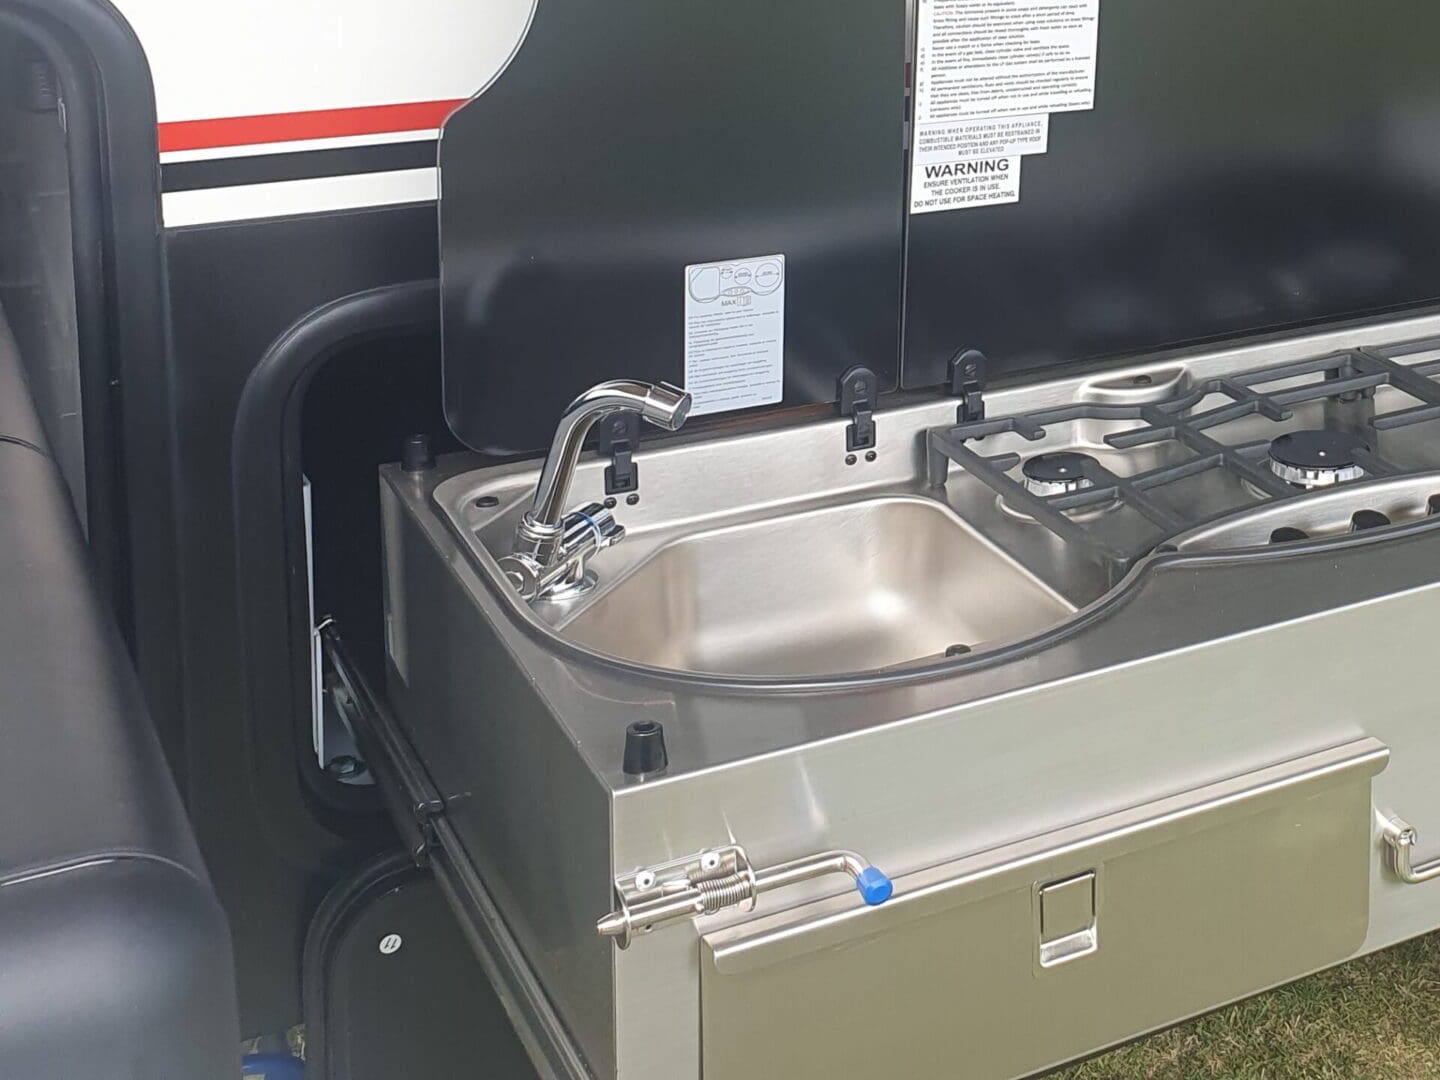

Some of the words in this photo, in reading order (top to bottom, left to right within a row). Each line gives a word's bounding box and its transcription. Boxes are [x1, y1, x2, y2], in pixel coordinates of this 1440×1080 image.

[925, 159, 1009, 178] WARNING
[924, 179, 948, 188] ENSURE
[950, 175, 989, 186] VENTILATION
[991, 173, 1008, 181] WHEN
[945, 187, 971, 195] COOKER
[914, 200, 923, 208] DO
[925, 199, 938, 207] NOT
[953, 196, 966, 204] FOR
[967, 194, 986, 202] SPACE
